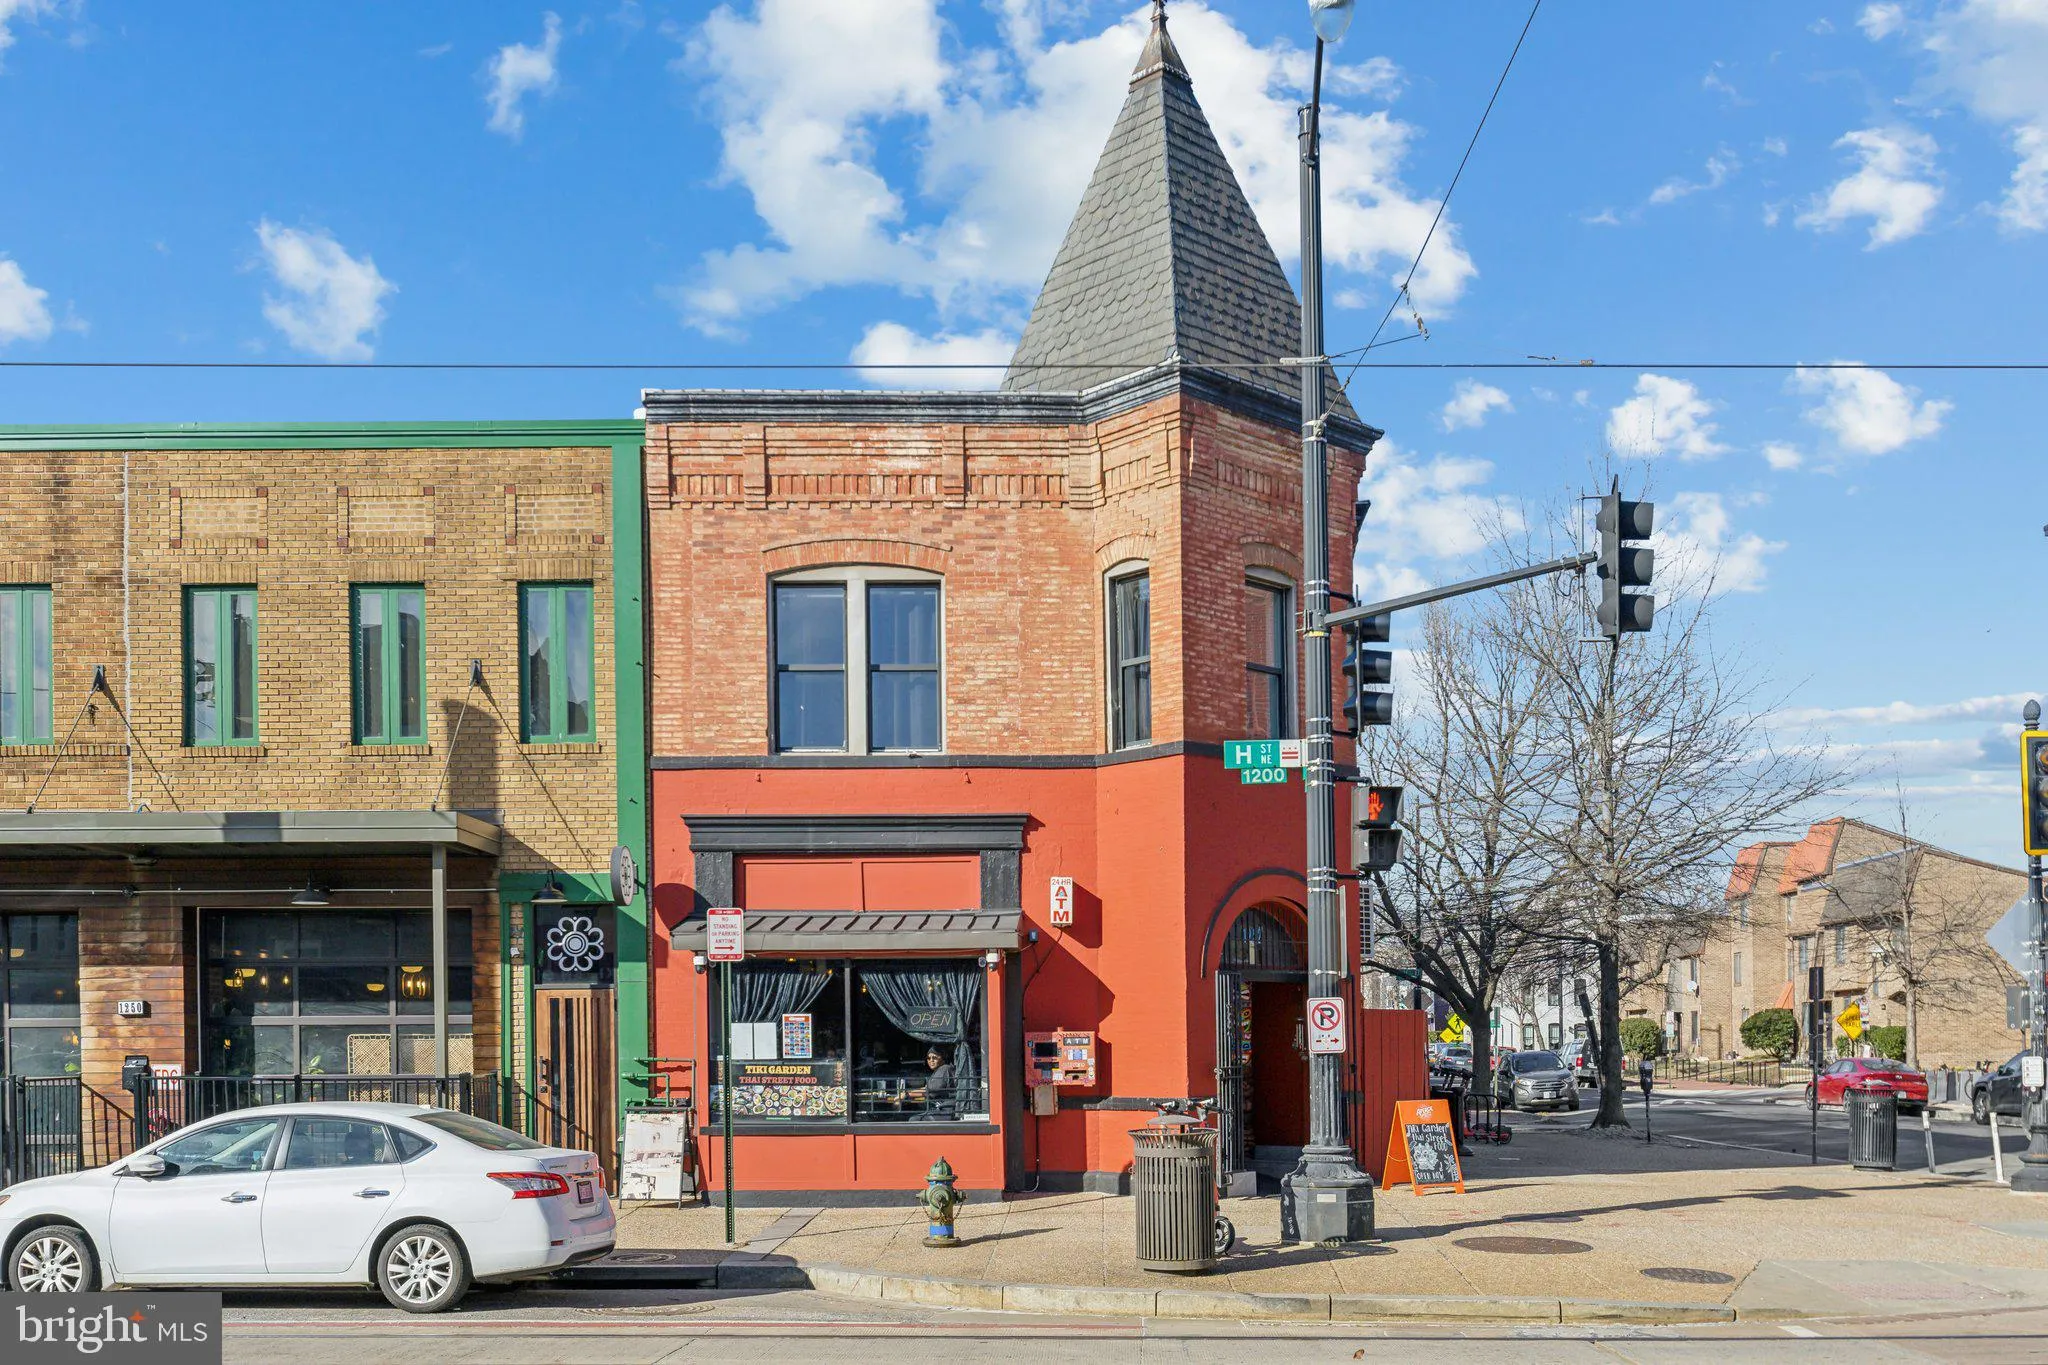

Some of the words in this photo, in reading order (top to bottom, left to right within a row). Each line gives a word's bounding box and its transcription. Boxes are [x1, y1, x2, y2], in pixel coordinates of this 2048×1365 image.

[1235, 745, 1252, 765] H
[1260, 743, 1273, 754] ST
[1260, 755, 1273, 764] NE
[1243, 768, 1285, 783] 1200
[1053, 886, 1069, 922] ATM
[119, 1002, 142, 1014] 1250
[910, 1013, 952, 1027] OPEN
[745, 1065, 767, 1075] TIKI
[768, 1065, 812, 1075] GARDEN
[739, 1076, 761, 1084] THAI
[762, 1076, 794, 1084] STREET
[795, 1076, 818, 1084] FOOD
